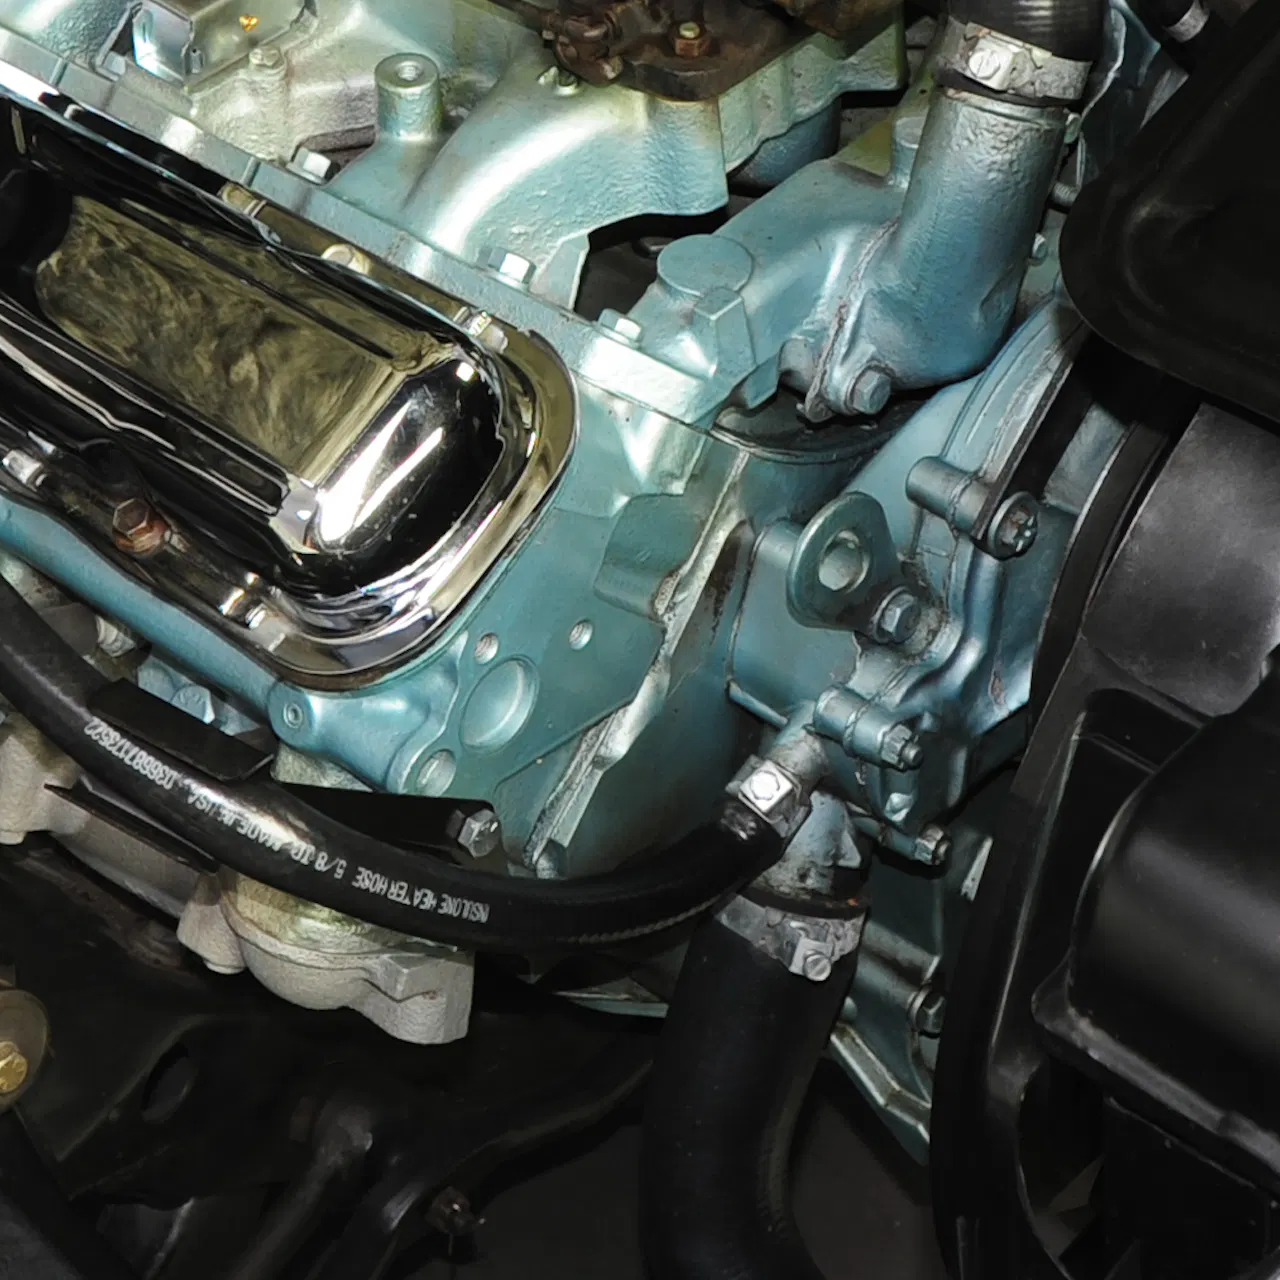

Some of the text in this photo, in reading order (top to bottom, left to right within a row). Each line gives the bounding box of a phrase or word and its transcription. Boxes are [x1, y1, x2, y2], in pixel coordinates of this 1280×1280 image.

[314, 848, 346, 879] 5/8
[352, 866, 389, 898] HOSE
[387, 879, 438, 912] HEATER
